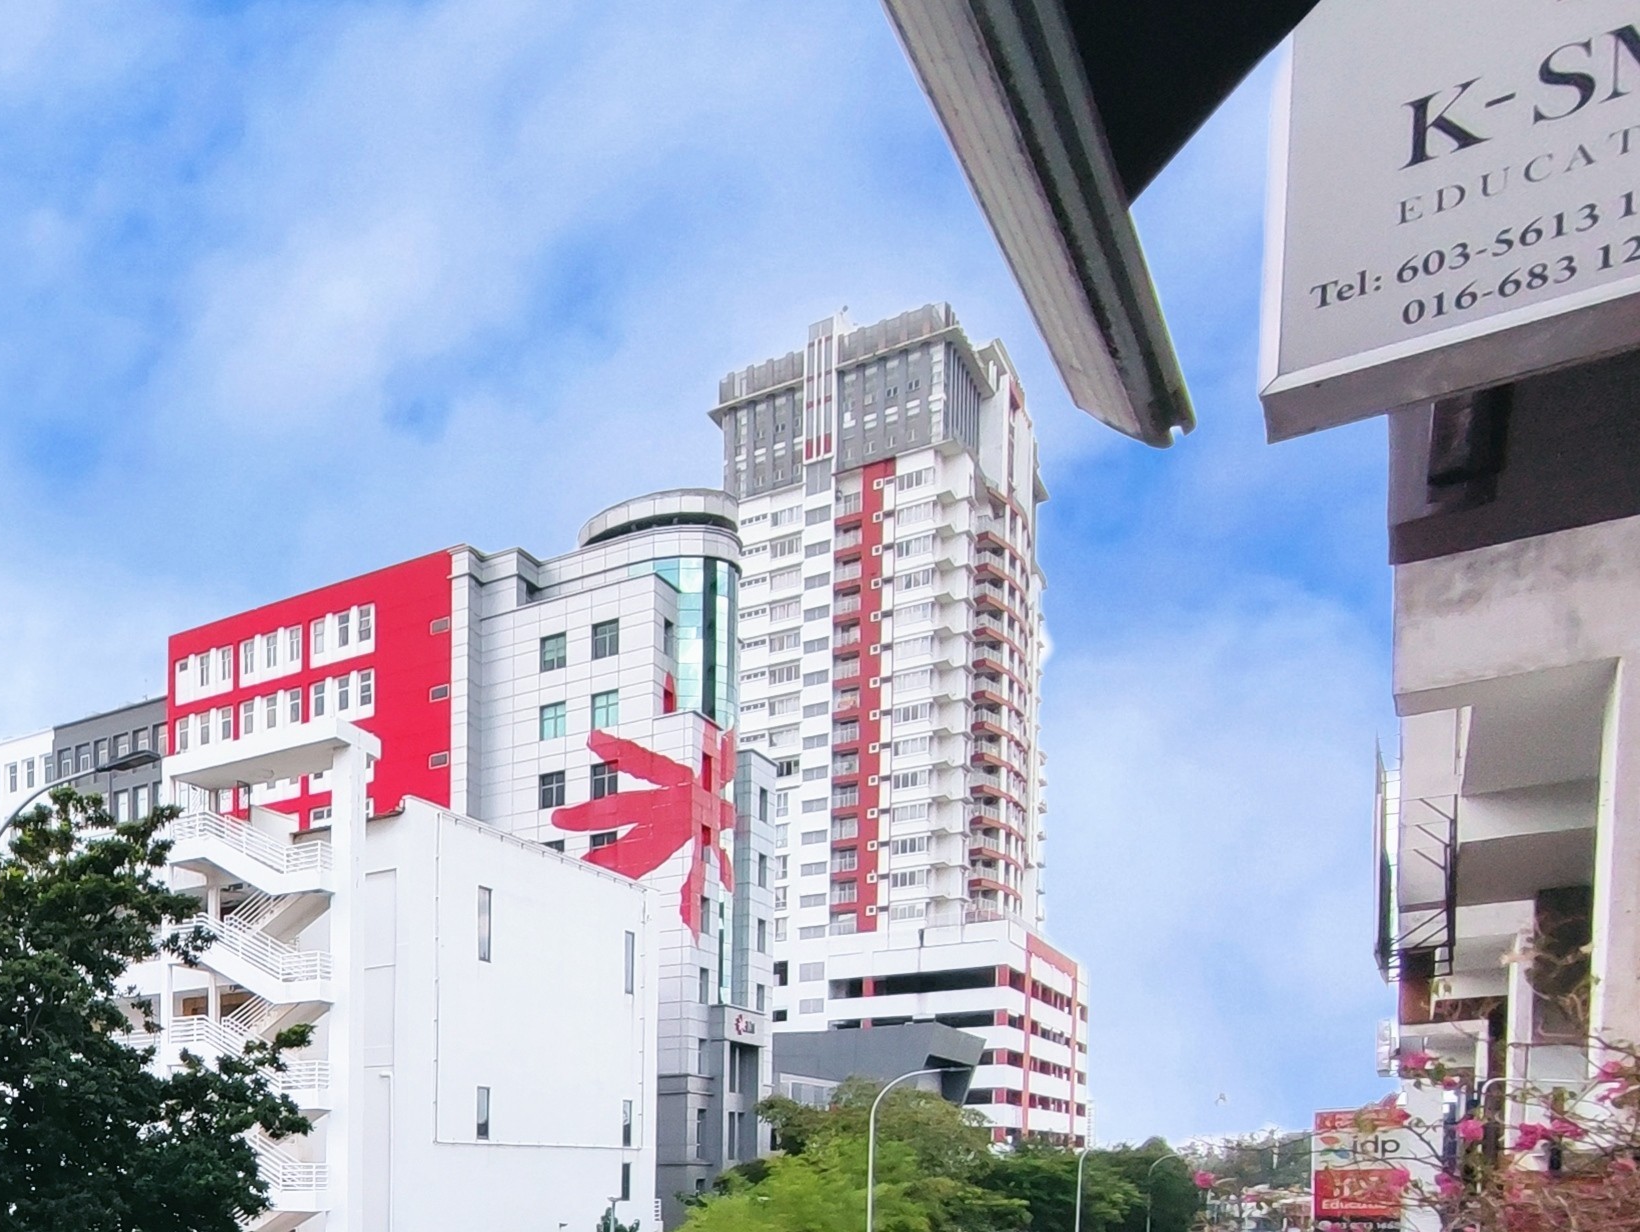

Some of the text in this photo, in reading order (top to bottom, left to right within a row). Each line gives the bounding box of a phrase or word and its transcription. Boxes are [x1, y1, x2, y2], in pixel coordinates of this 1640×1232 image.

[1310, 270, 1382, 309] Tel:
[1396, 203, 1600, 284] 603-5613
[1402, 255, 1578, 325] 016-683
[1353, 1134, 1400, 1158] idp
